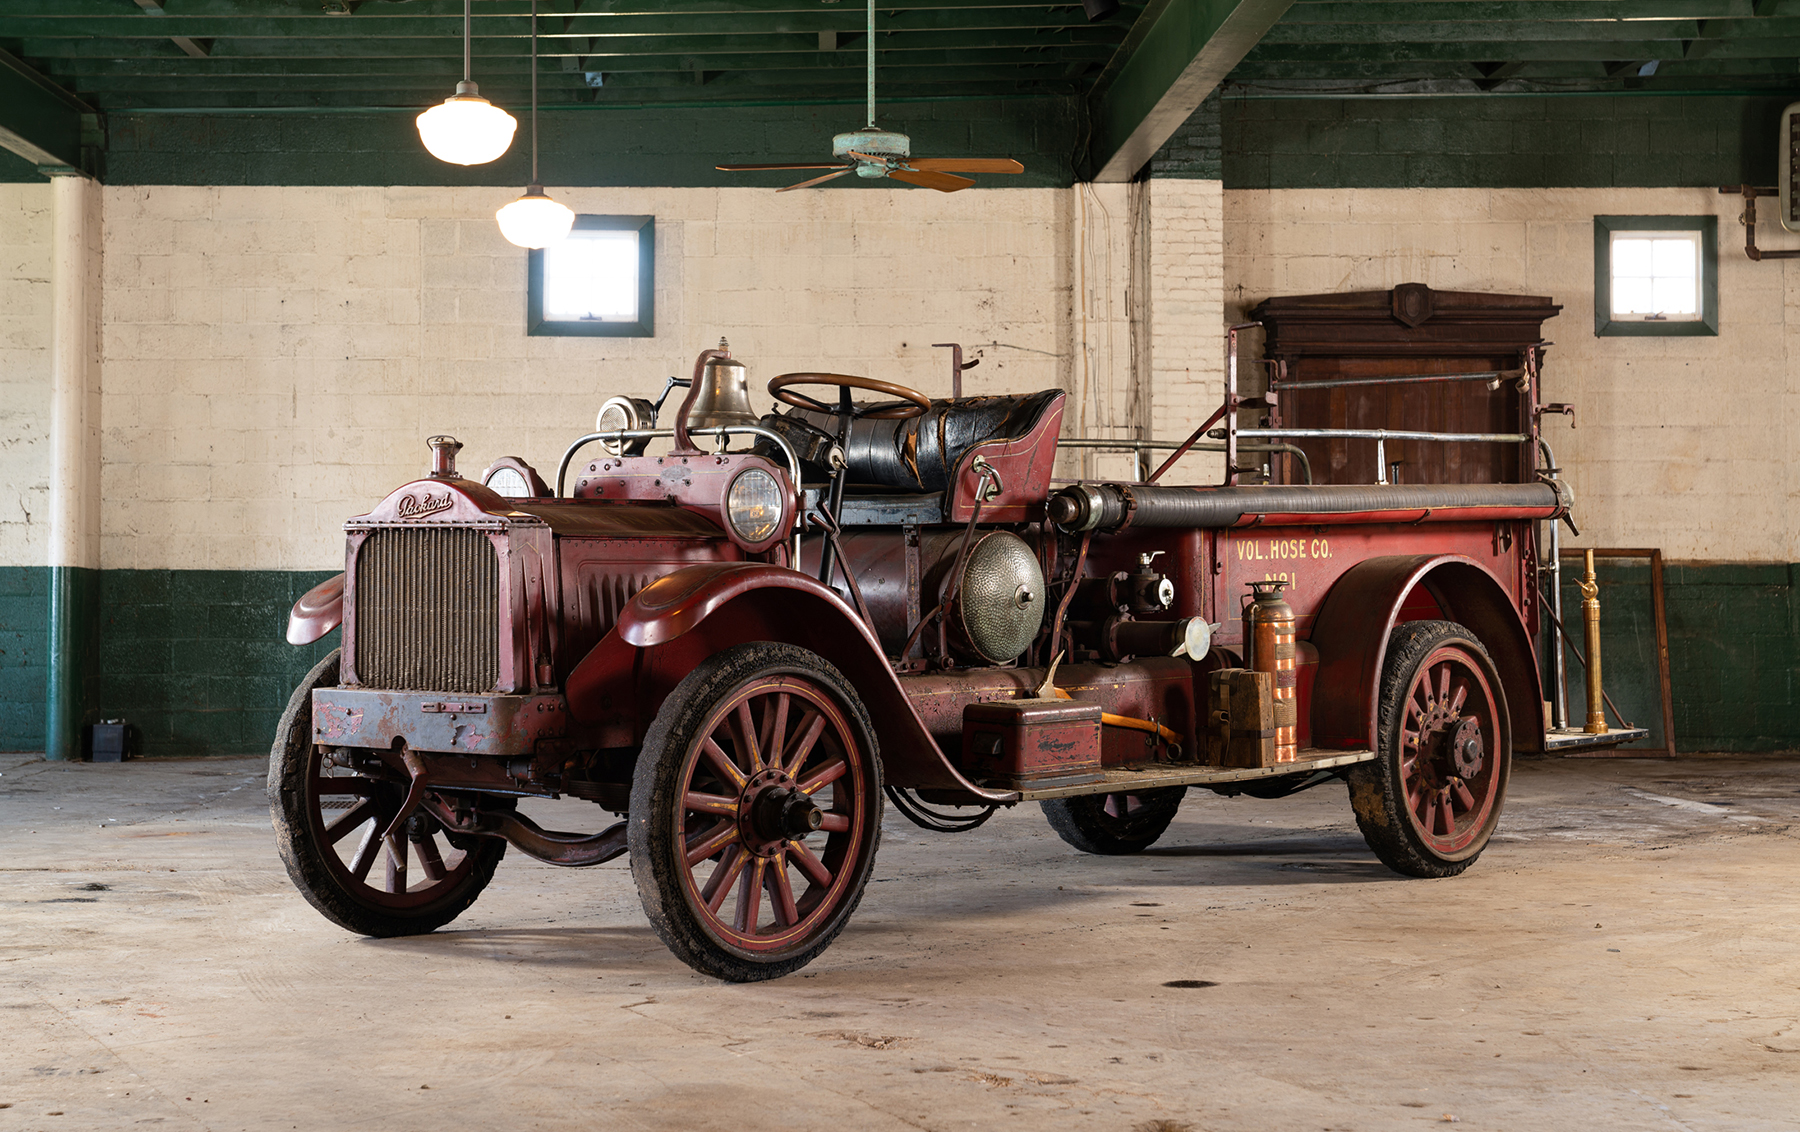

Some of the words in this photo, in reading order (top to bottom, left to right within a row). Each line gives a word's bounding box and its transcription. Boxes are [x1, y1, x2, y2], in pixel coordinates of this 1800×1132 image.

[397, 492, 454, 519] Packard
[1236, 540, 1269, 561] VOL.
[1270, 539, 1307, 559] HOSE
[1311, 538, 1333, 559] CO.
[1291, 571, 1296, 590] 1
